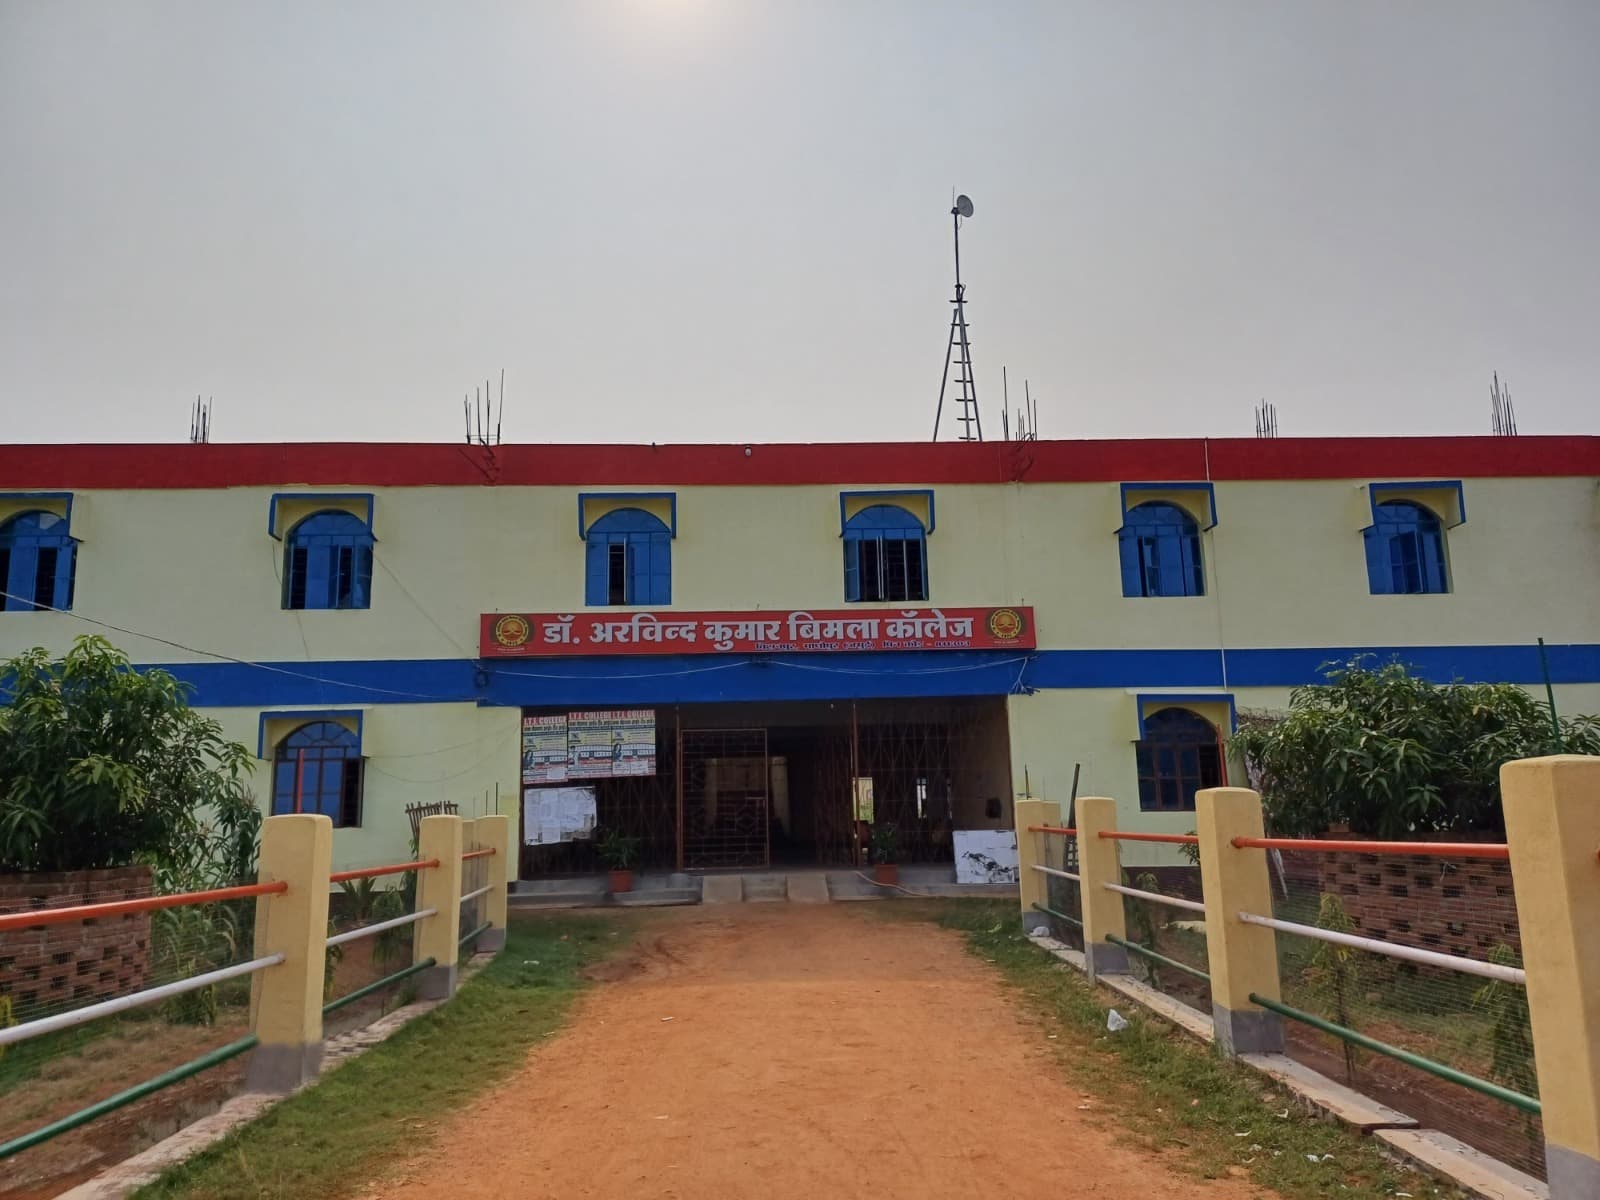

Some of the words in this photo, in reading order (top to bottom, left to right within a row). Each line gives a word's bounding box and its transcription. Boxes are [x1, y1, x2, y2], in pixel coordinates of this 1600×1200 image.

[542, 614, 580, 645] डॉ.
[589, 612, 698, 645] अरविन्द
[703, 620, 782, 651] कुमार
[787, 611, 881, 641] बिमला
[884, 608, 975, 640] कॉलेज
